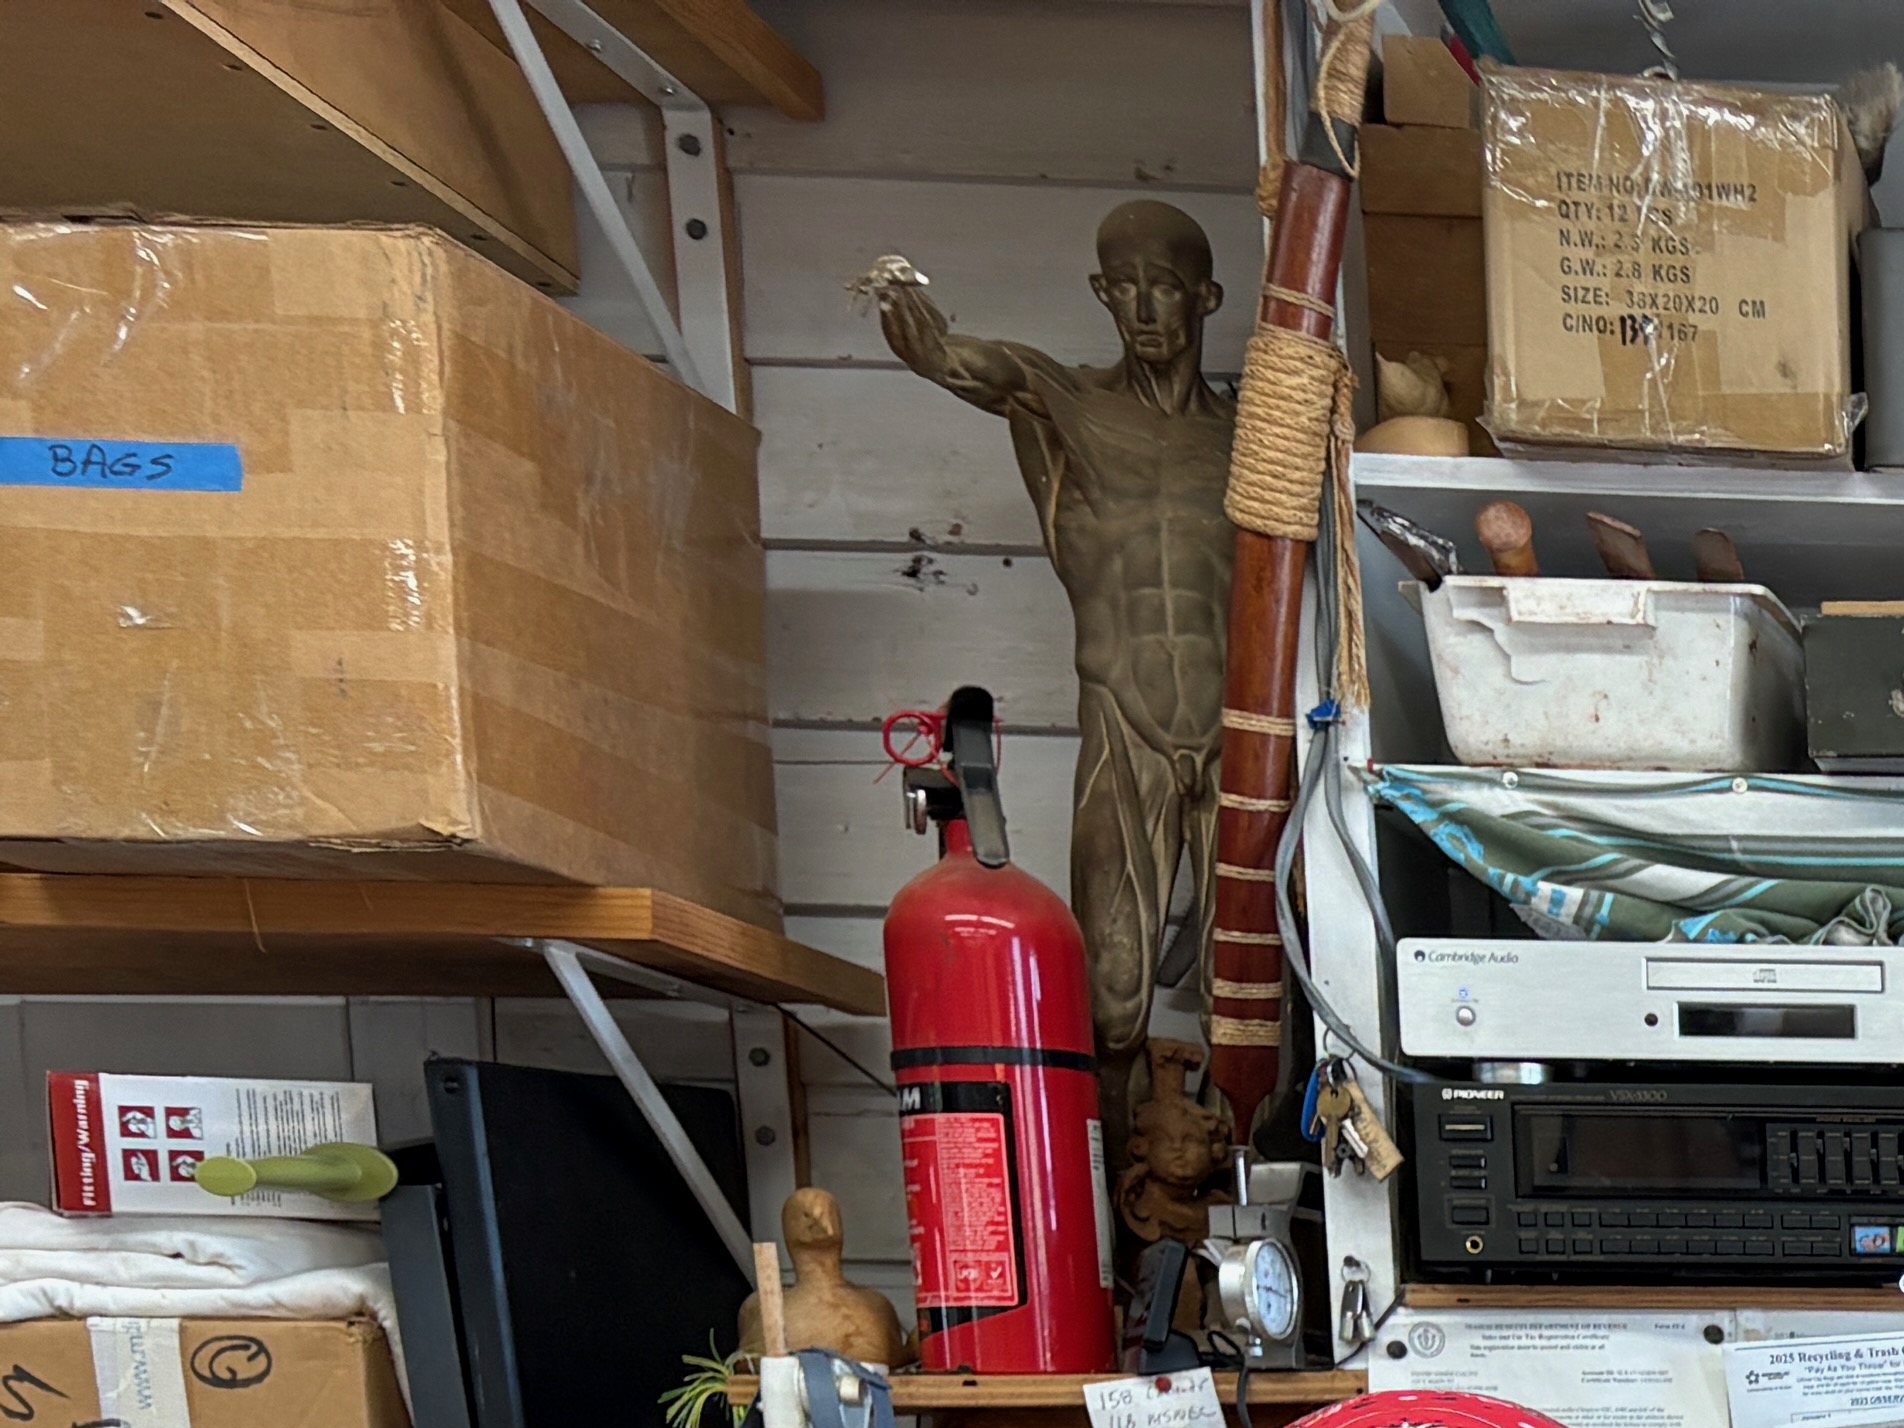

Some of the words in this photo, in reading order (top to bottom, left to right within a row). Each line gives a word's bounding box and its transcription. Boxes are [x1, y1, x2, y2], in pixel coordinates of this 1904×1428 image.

[1558, 202, 1602, 221] QTY:
[1607, 203, 1628, 222] 12
[1652, 237, 1690, 256] KGS
[1614, 260, 1642, 280] 2.8
[1652, 263, 1691, 284] KGS
[1561, 285, 1610, 307] SIZE:
[1738, 299, 1766, 319] CM
[49, 444, 175, 480] BAGS
[1428, 951, 1486, 964] Cambridge
[1488, 952, 1519, 964] Audio
[1453, 1090, 1504, 1100] PIONEER
[73, 1080, 96, 1206] Fitting/Warning
[1770, 1354, 1795, 1364] 2025
[1798, 1350, 1851, 1364] Recycling
[1854, 1349, 1864, 1359] &
[1868, 1346, 1899, 1358] Trash
[1100, 1390, 1133, 1411] 158
